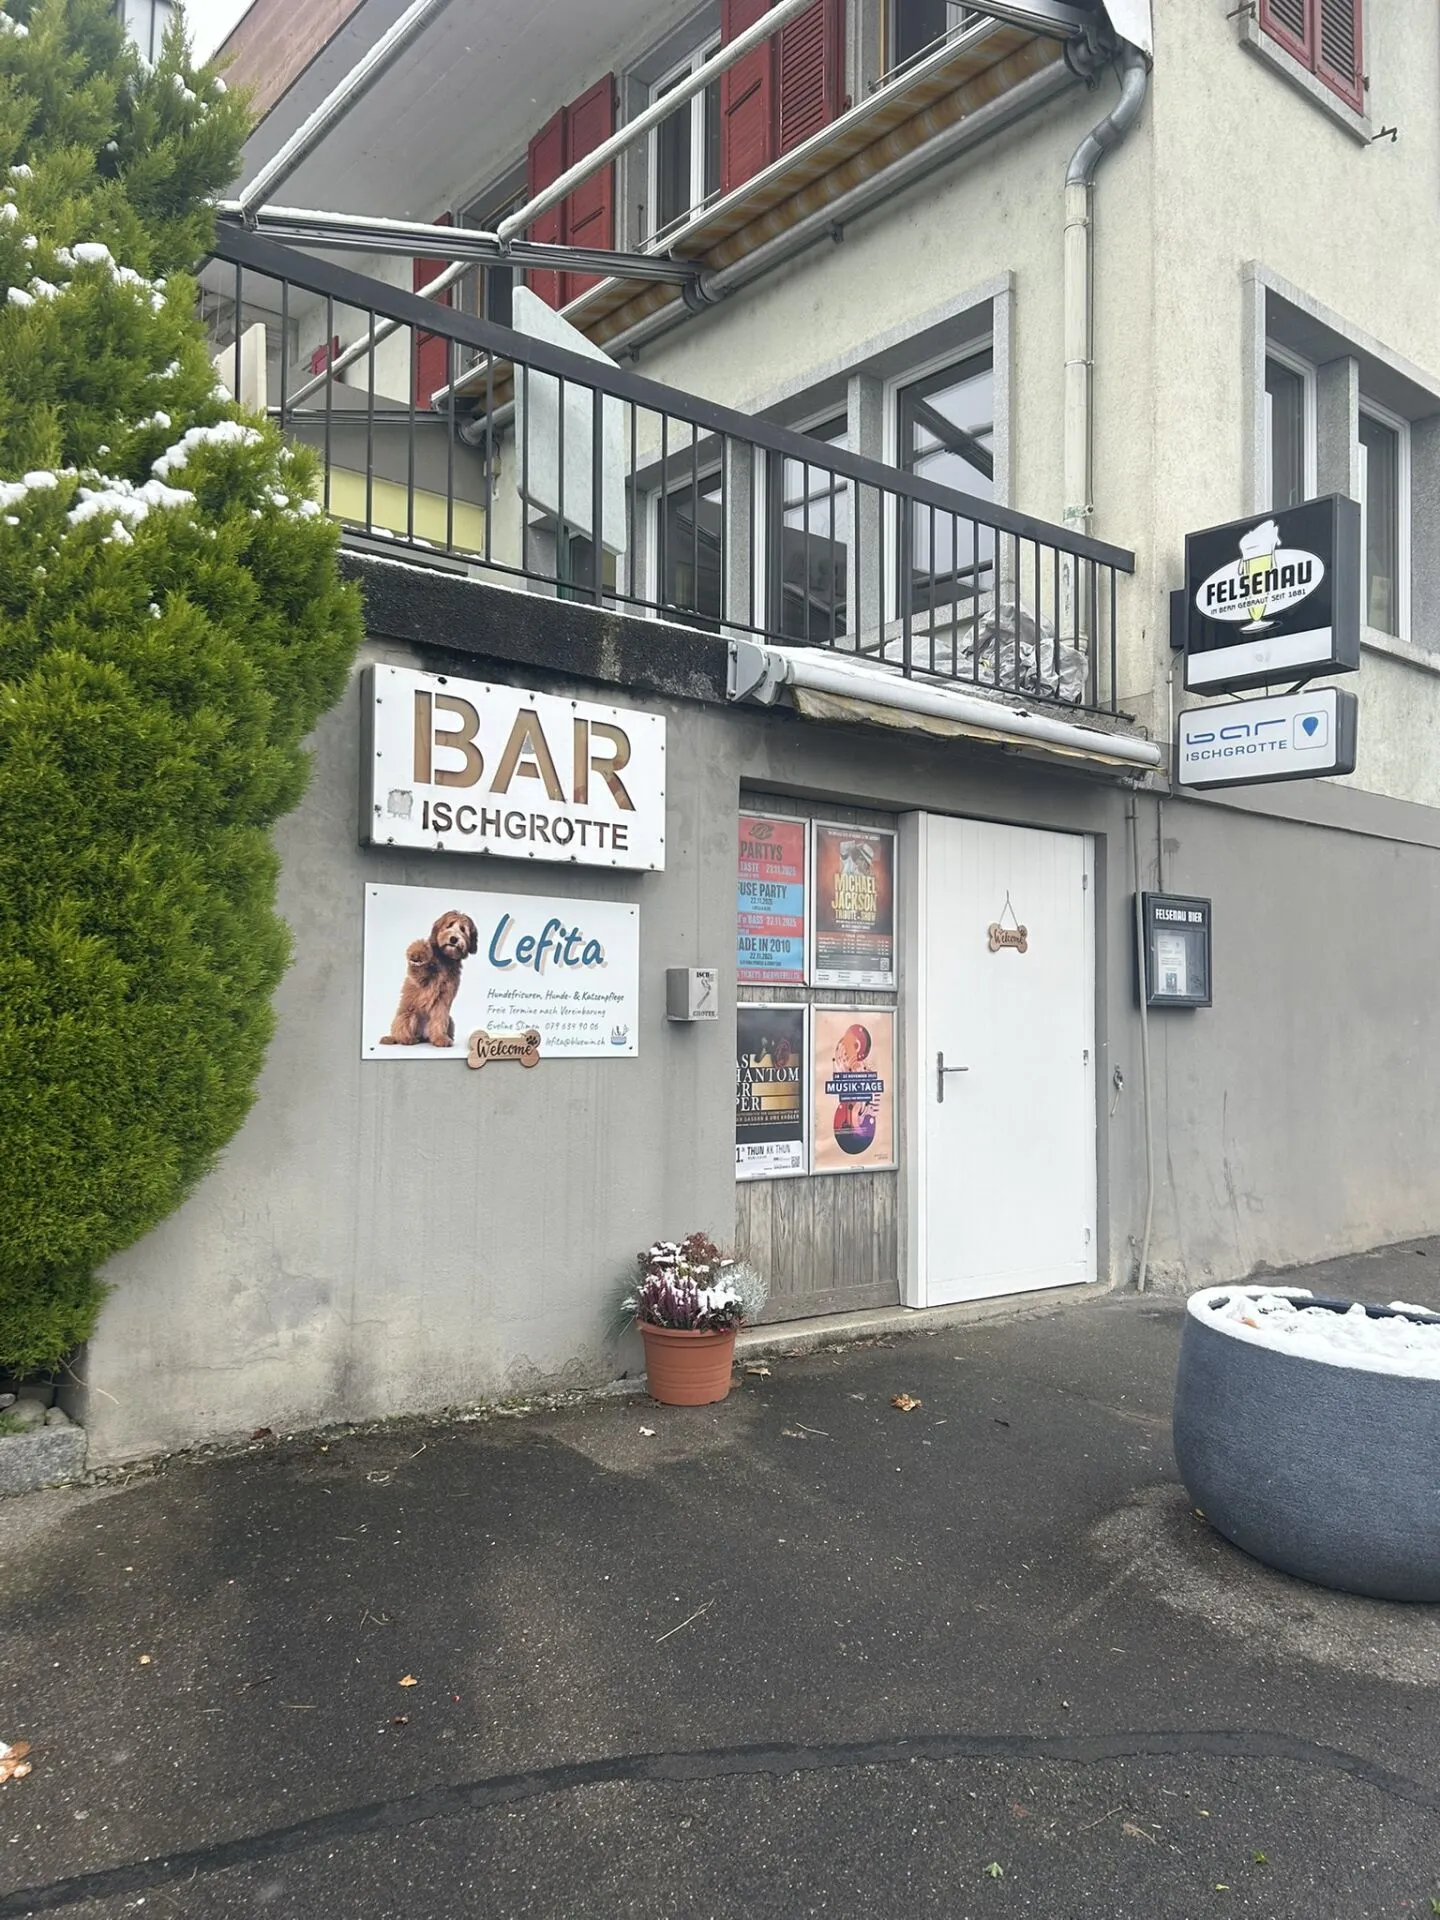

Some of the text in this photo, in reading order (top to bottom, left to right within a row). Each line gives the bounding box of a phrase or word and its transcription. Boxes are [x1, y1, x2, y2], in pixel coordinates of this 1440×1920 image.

[1207, 560, 1312, 606] FELSENAU
[1237, 597, 1269, 609] GEBRAUT
[1271, 592, 1286, 602] SEIT
[1186, 719, 1286, 745] bar
[413, 689, 636, 811] BAR
[1186, 739, 1288, 762] ISCHGROTTE
[422, 800, 628, 850] ISCHGROTTE
[740, 841, 782, 861] PARTYS
[738, 881, 787, 899] USE PARTY
[834, 873, 876, 893] MICHAEL
[831, 891, 877, 911] JACKSON
[835, 909, 857, 920] TRIBUTE
[1155, 908, 1203, 923] FELSENAU BIER
[488, 913, 605, 973] Lefita
[737, 937, 791, 953] ADE IN 2010
[573, 991, 580, 1001] &
[581, 991, 624, 1003] Katzenpflege
[508, 1005, 538, 1015] Termine
[560, 1006, 606, 1018] Vereinbarung
[545, 1022, 559, 1031] 079
[477, 1038, 533, 1058] Welcome
[747, 1145, 765, 1156] THUN
[775, 1144, 791, 1154] THUN
